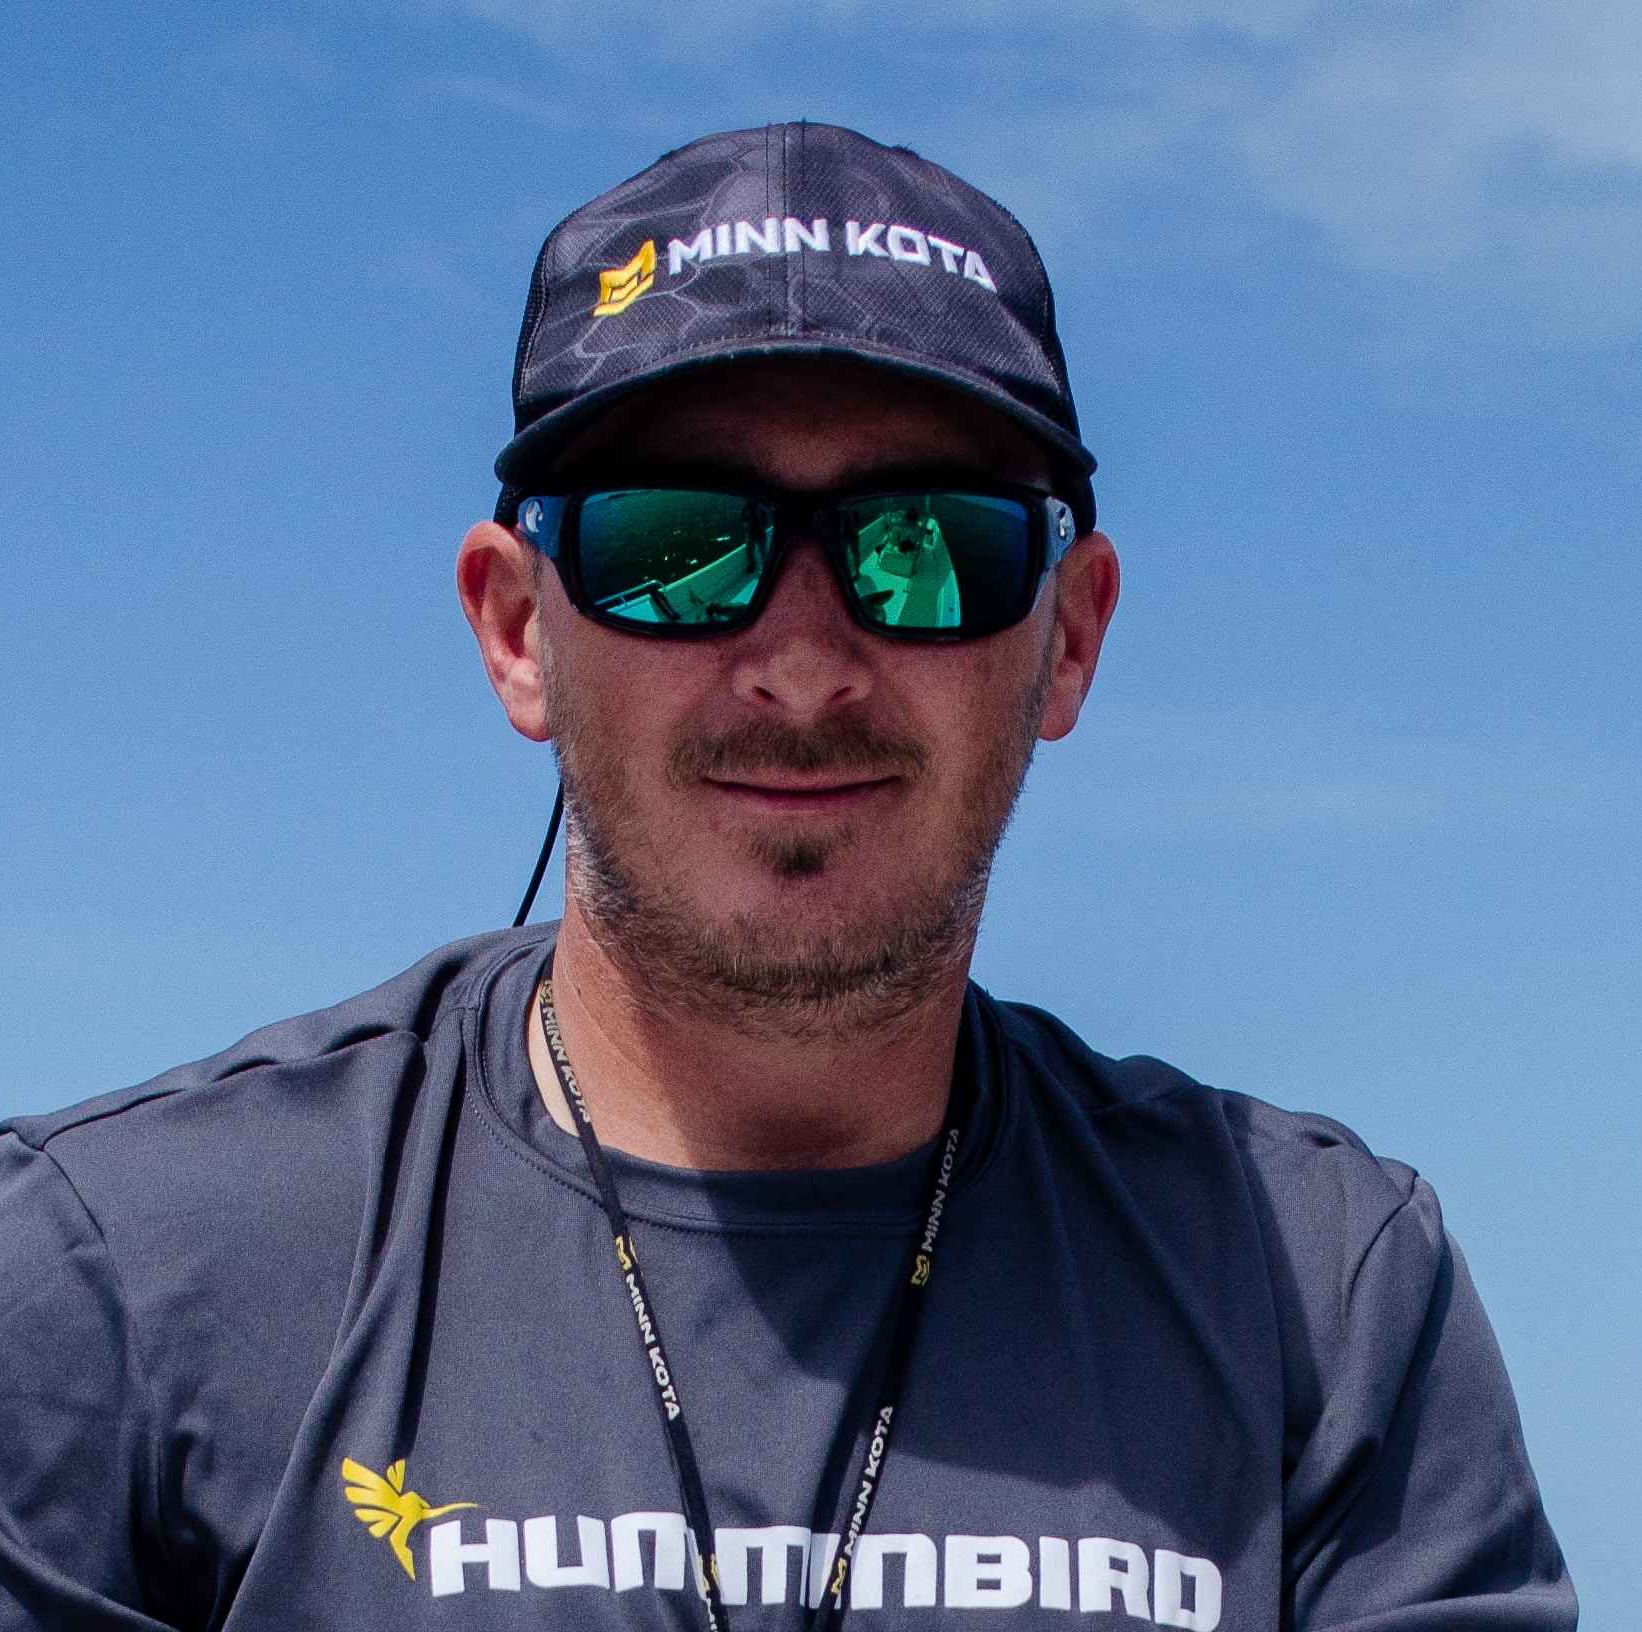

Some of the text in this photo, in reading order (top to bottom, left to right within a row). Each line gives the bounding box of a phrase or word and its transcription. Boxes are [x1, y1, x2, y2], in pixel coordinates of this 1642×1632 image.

[668, 216, 999, 294] MINN KOTA
[542, 1006, 569, 1062] MINN
[920, 1128, 960, 1253] MINN KOTA
[648, 1346, 681, 1421] KOTA
[843, 1405, 894, 1558] MINN KOTA
